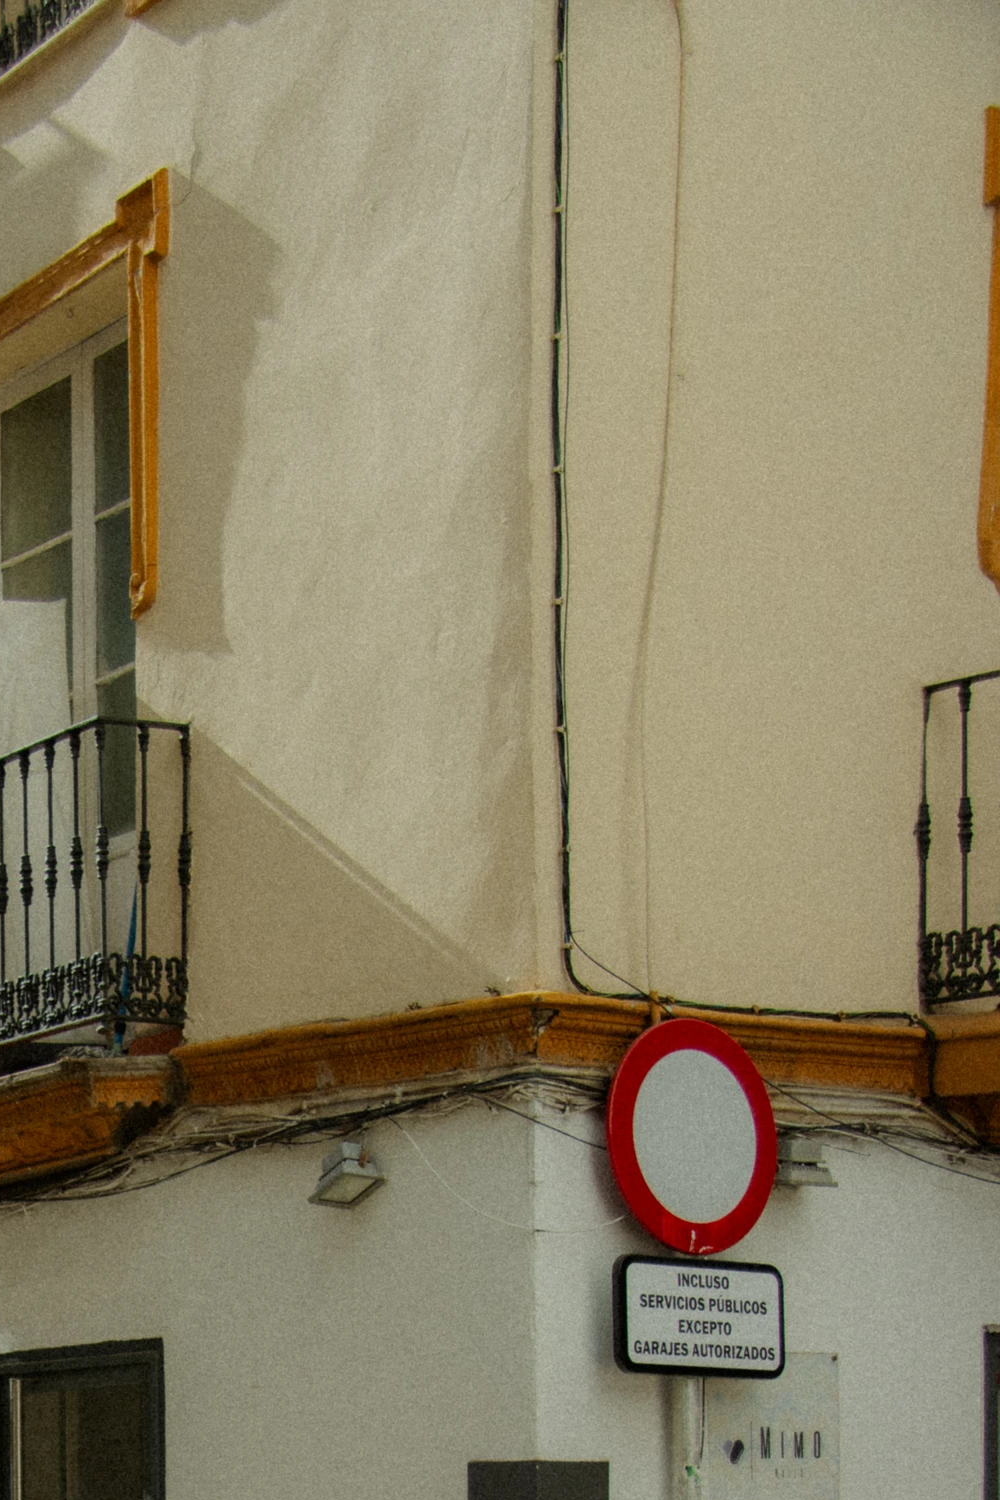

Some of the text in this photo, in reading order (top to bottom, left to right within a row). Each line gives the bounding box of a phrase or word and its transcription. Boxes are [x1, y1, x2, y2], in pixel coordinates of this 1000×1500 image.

[677, 1273, 729, 1290] INCLUSO
[639, 1294, 767, 1315] SERVICIOS PÚBLICOS
[678, 1319, 732, 1336] EXCEPTO
[634, 1340, 775, 1361] GARAJES AUTORIZADOS
[760, 1426, 821, 1459] MIMO
